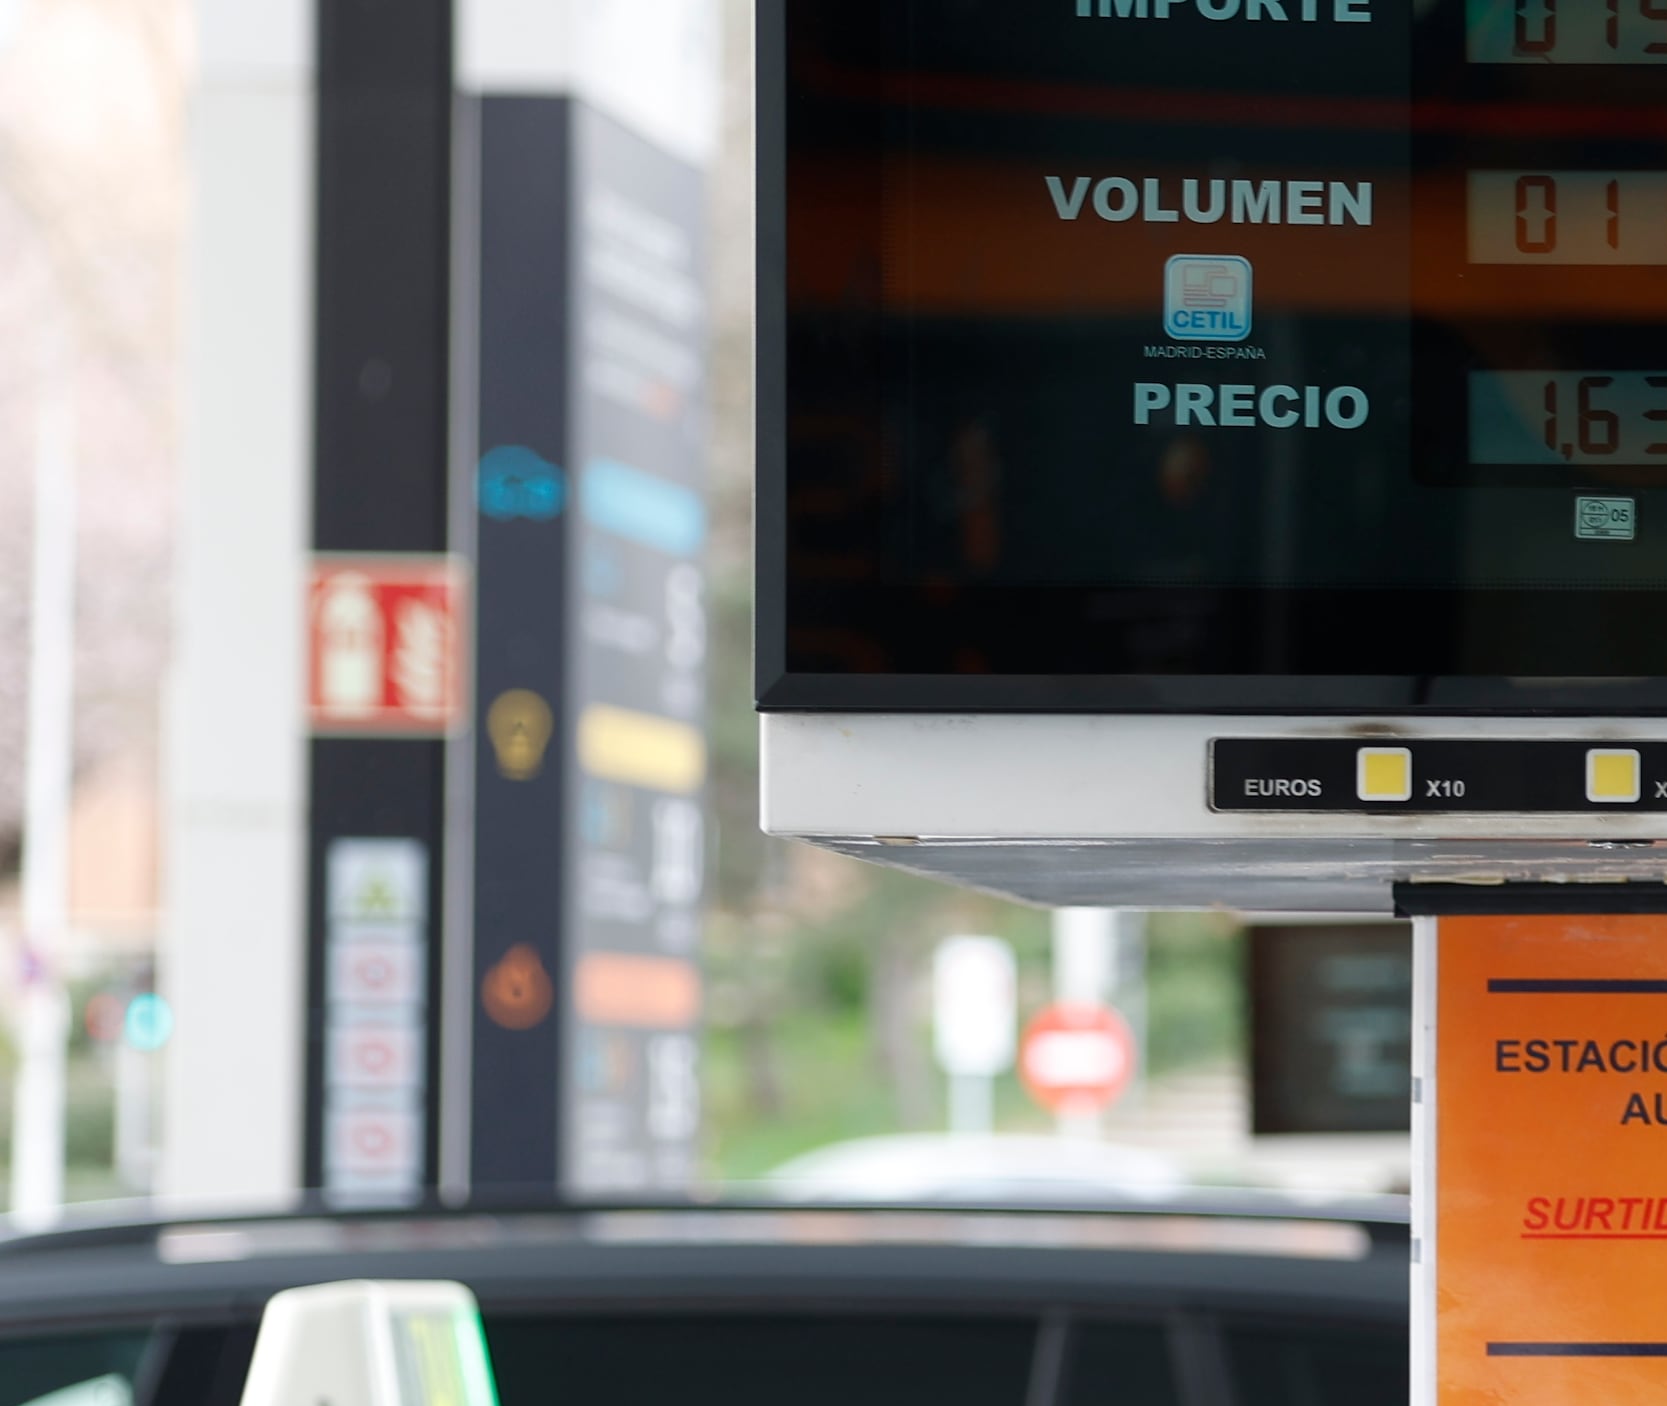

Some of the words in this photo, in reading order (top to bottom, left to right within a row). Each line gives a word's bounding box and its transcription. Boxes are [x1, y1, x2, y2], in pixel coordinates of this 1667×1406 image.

[1044, 176, 1373, 227] VOLUMEN
[1171, 308, 1245, 332] CETIL
[1143, 344, 1267, 361] MADRID-ESPAÑA
[1133, 382, 1370, 430] PRECIO
[1611, 508, 1629, 522] 05
[1244, 778, 1322, 797] EUROS
[1425, 779, 1466, 798] X10
